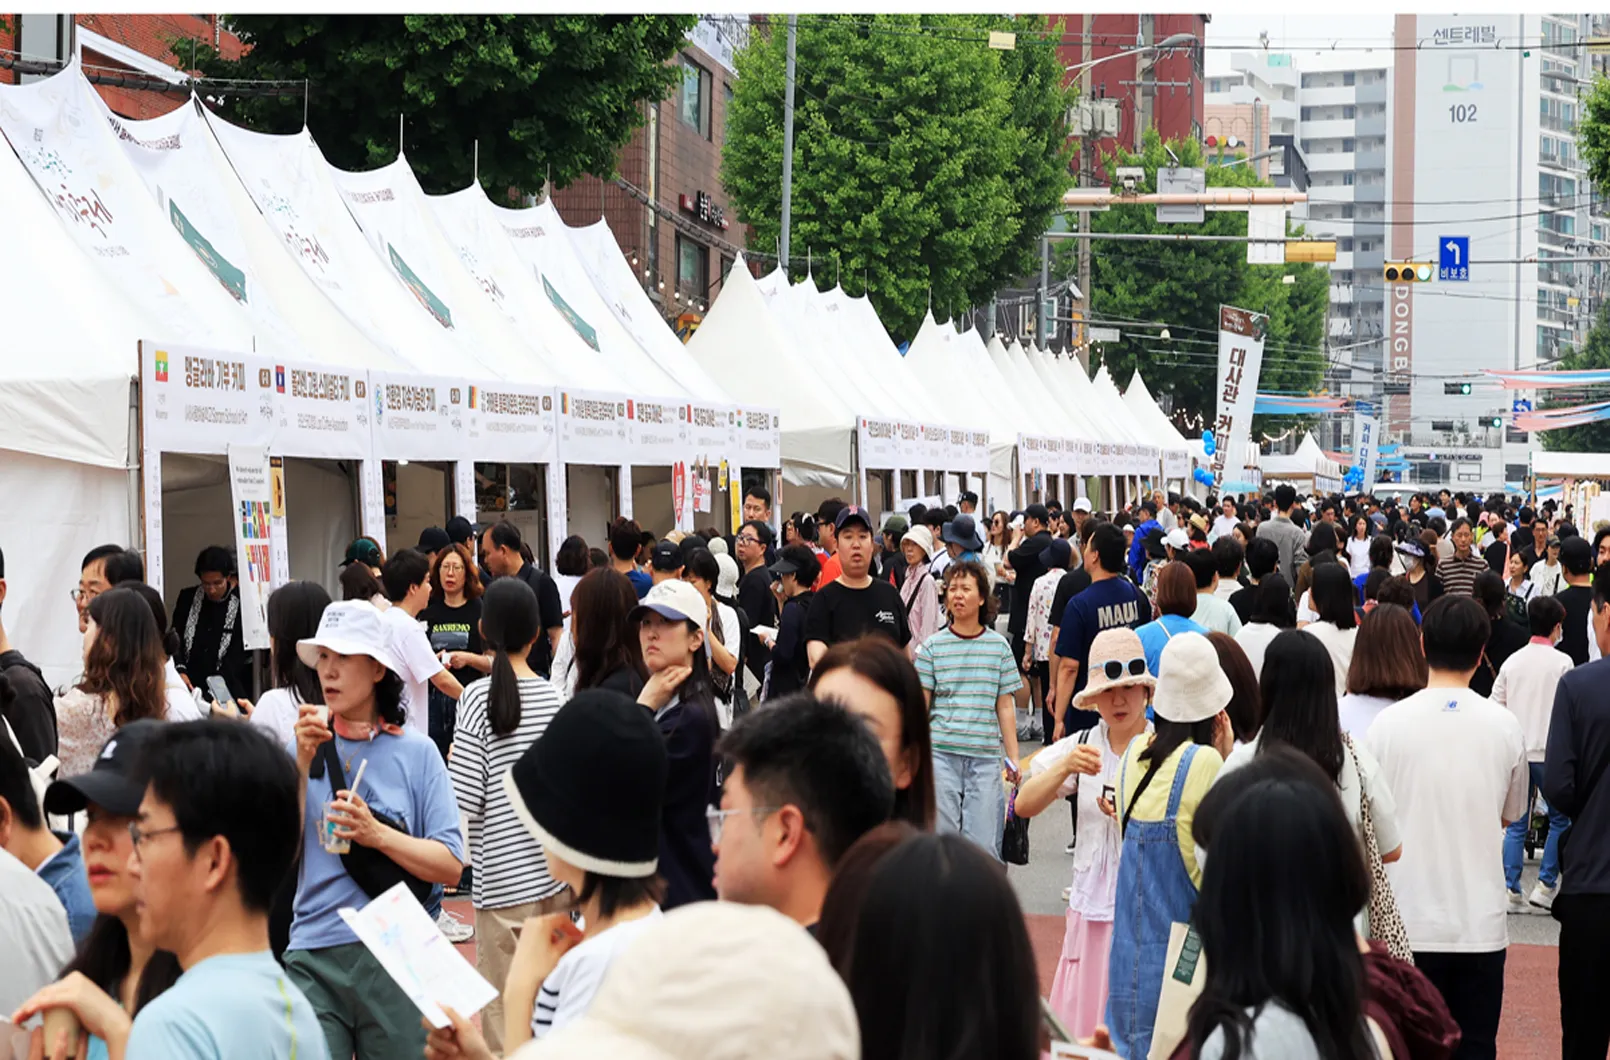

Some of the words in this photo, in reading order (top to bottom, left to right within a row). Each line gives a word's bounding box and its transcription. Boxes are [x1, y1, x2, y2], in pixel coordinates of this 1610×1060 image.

[1433, 25, 1496, 46] 센트레빌
[1449, 104, 1478, 123] 102
[1440, 266, 1468, 281] 비보호
[231, 361, 246, 392] 커피
[339, 375, 351, 402] 커피
[426, 387, 436, 412] 커피
[1097, 600, 1139, 629] MAUI
[432, 622, 471, 633] SANREMO
